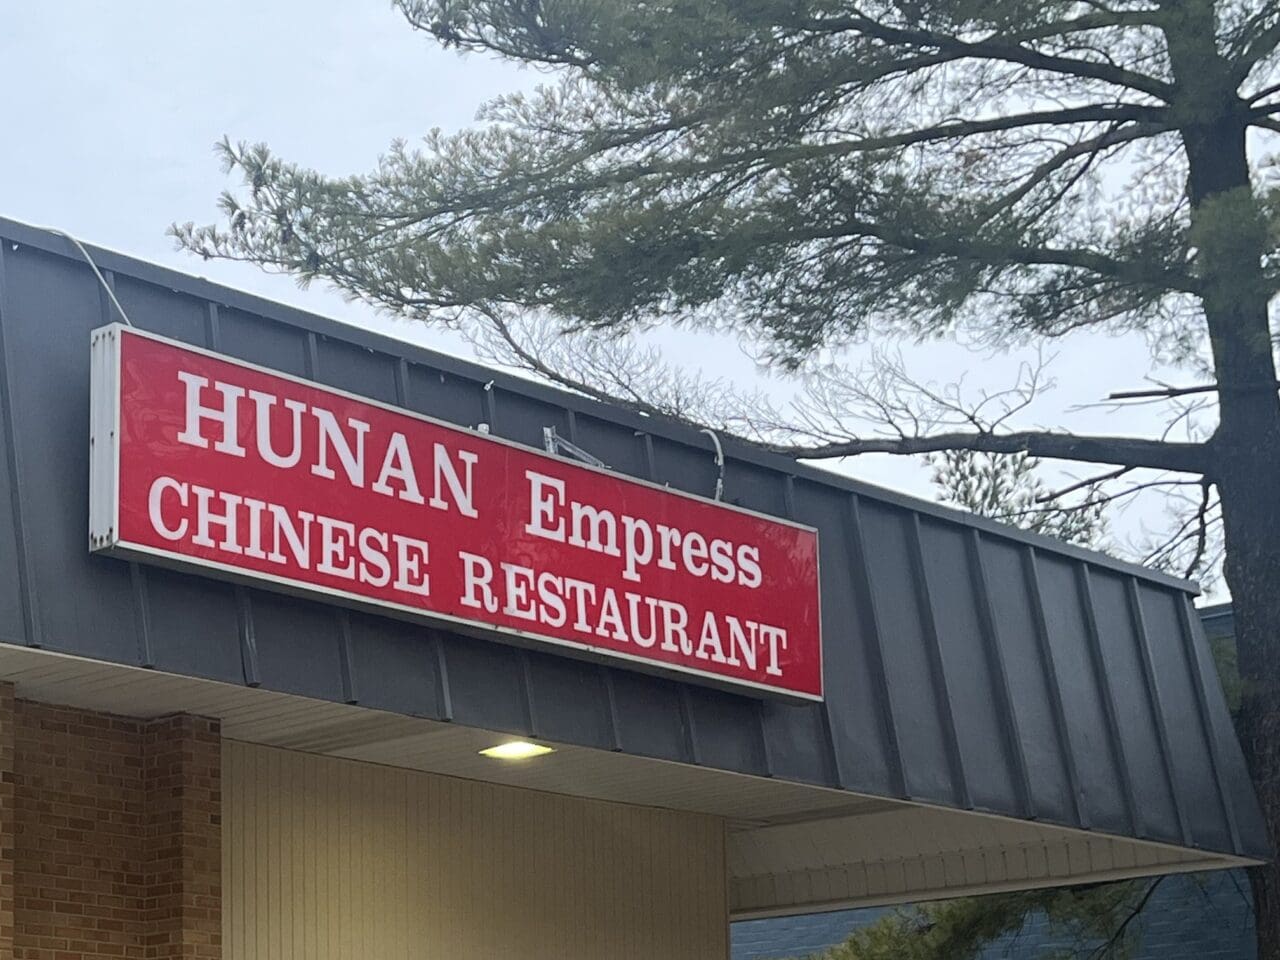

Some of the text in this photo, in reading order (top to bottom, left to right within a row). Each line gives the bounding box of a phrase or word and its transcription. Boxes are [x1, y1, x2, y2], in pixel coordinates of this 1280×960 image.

[149, 475, 788, 677] CHINESE RESTAURANT
[177, 370, 763, 589] HUNAN Empress
